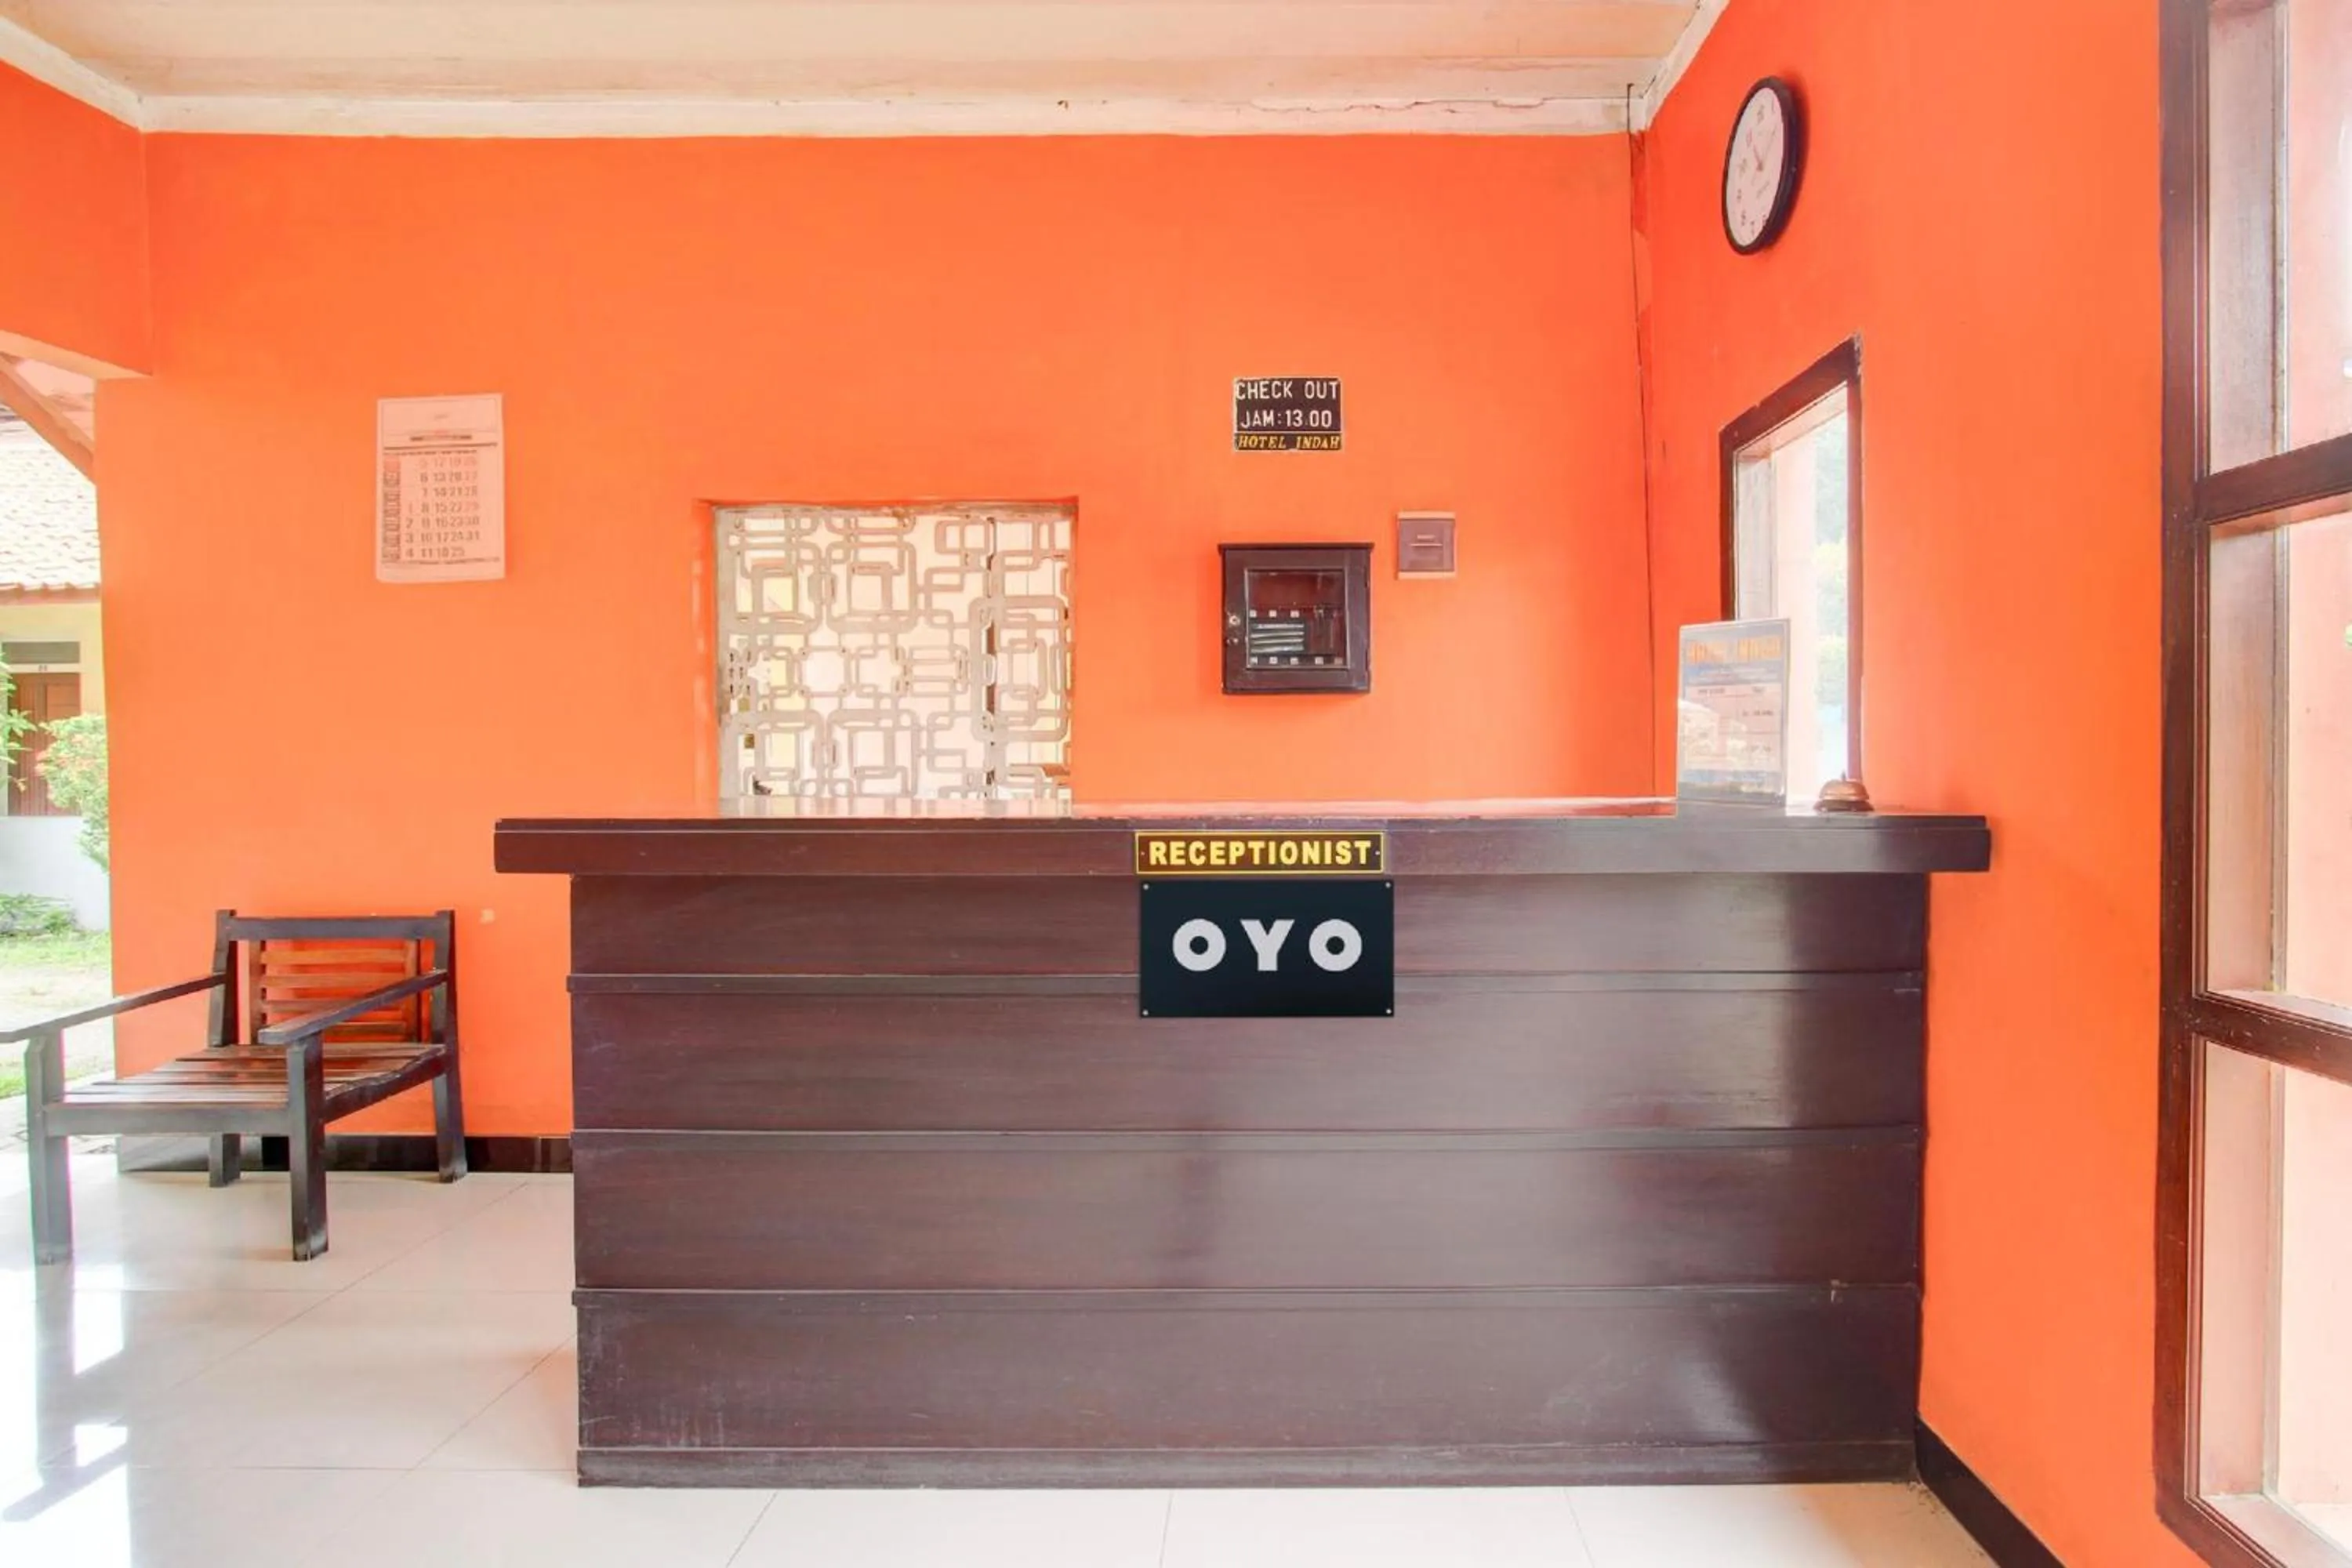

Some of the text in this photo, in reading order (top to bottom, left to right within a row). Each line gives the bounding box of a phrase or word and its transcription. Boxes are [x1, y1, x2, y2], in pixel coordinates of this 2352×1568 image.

[1236, 380, 1338, 400] CHECK OUT
[1238, 435, 1340, 449] HOTEL INDAH
[1149, 840, 1371, 865] RECEPTIONIST
[1172, 918, 1363, 972] OYO
